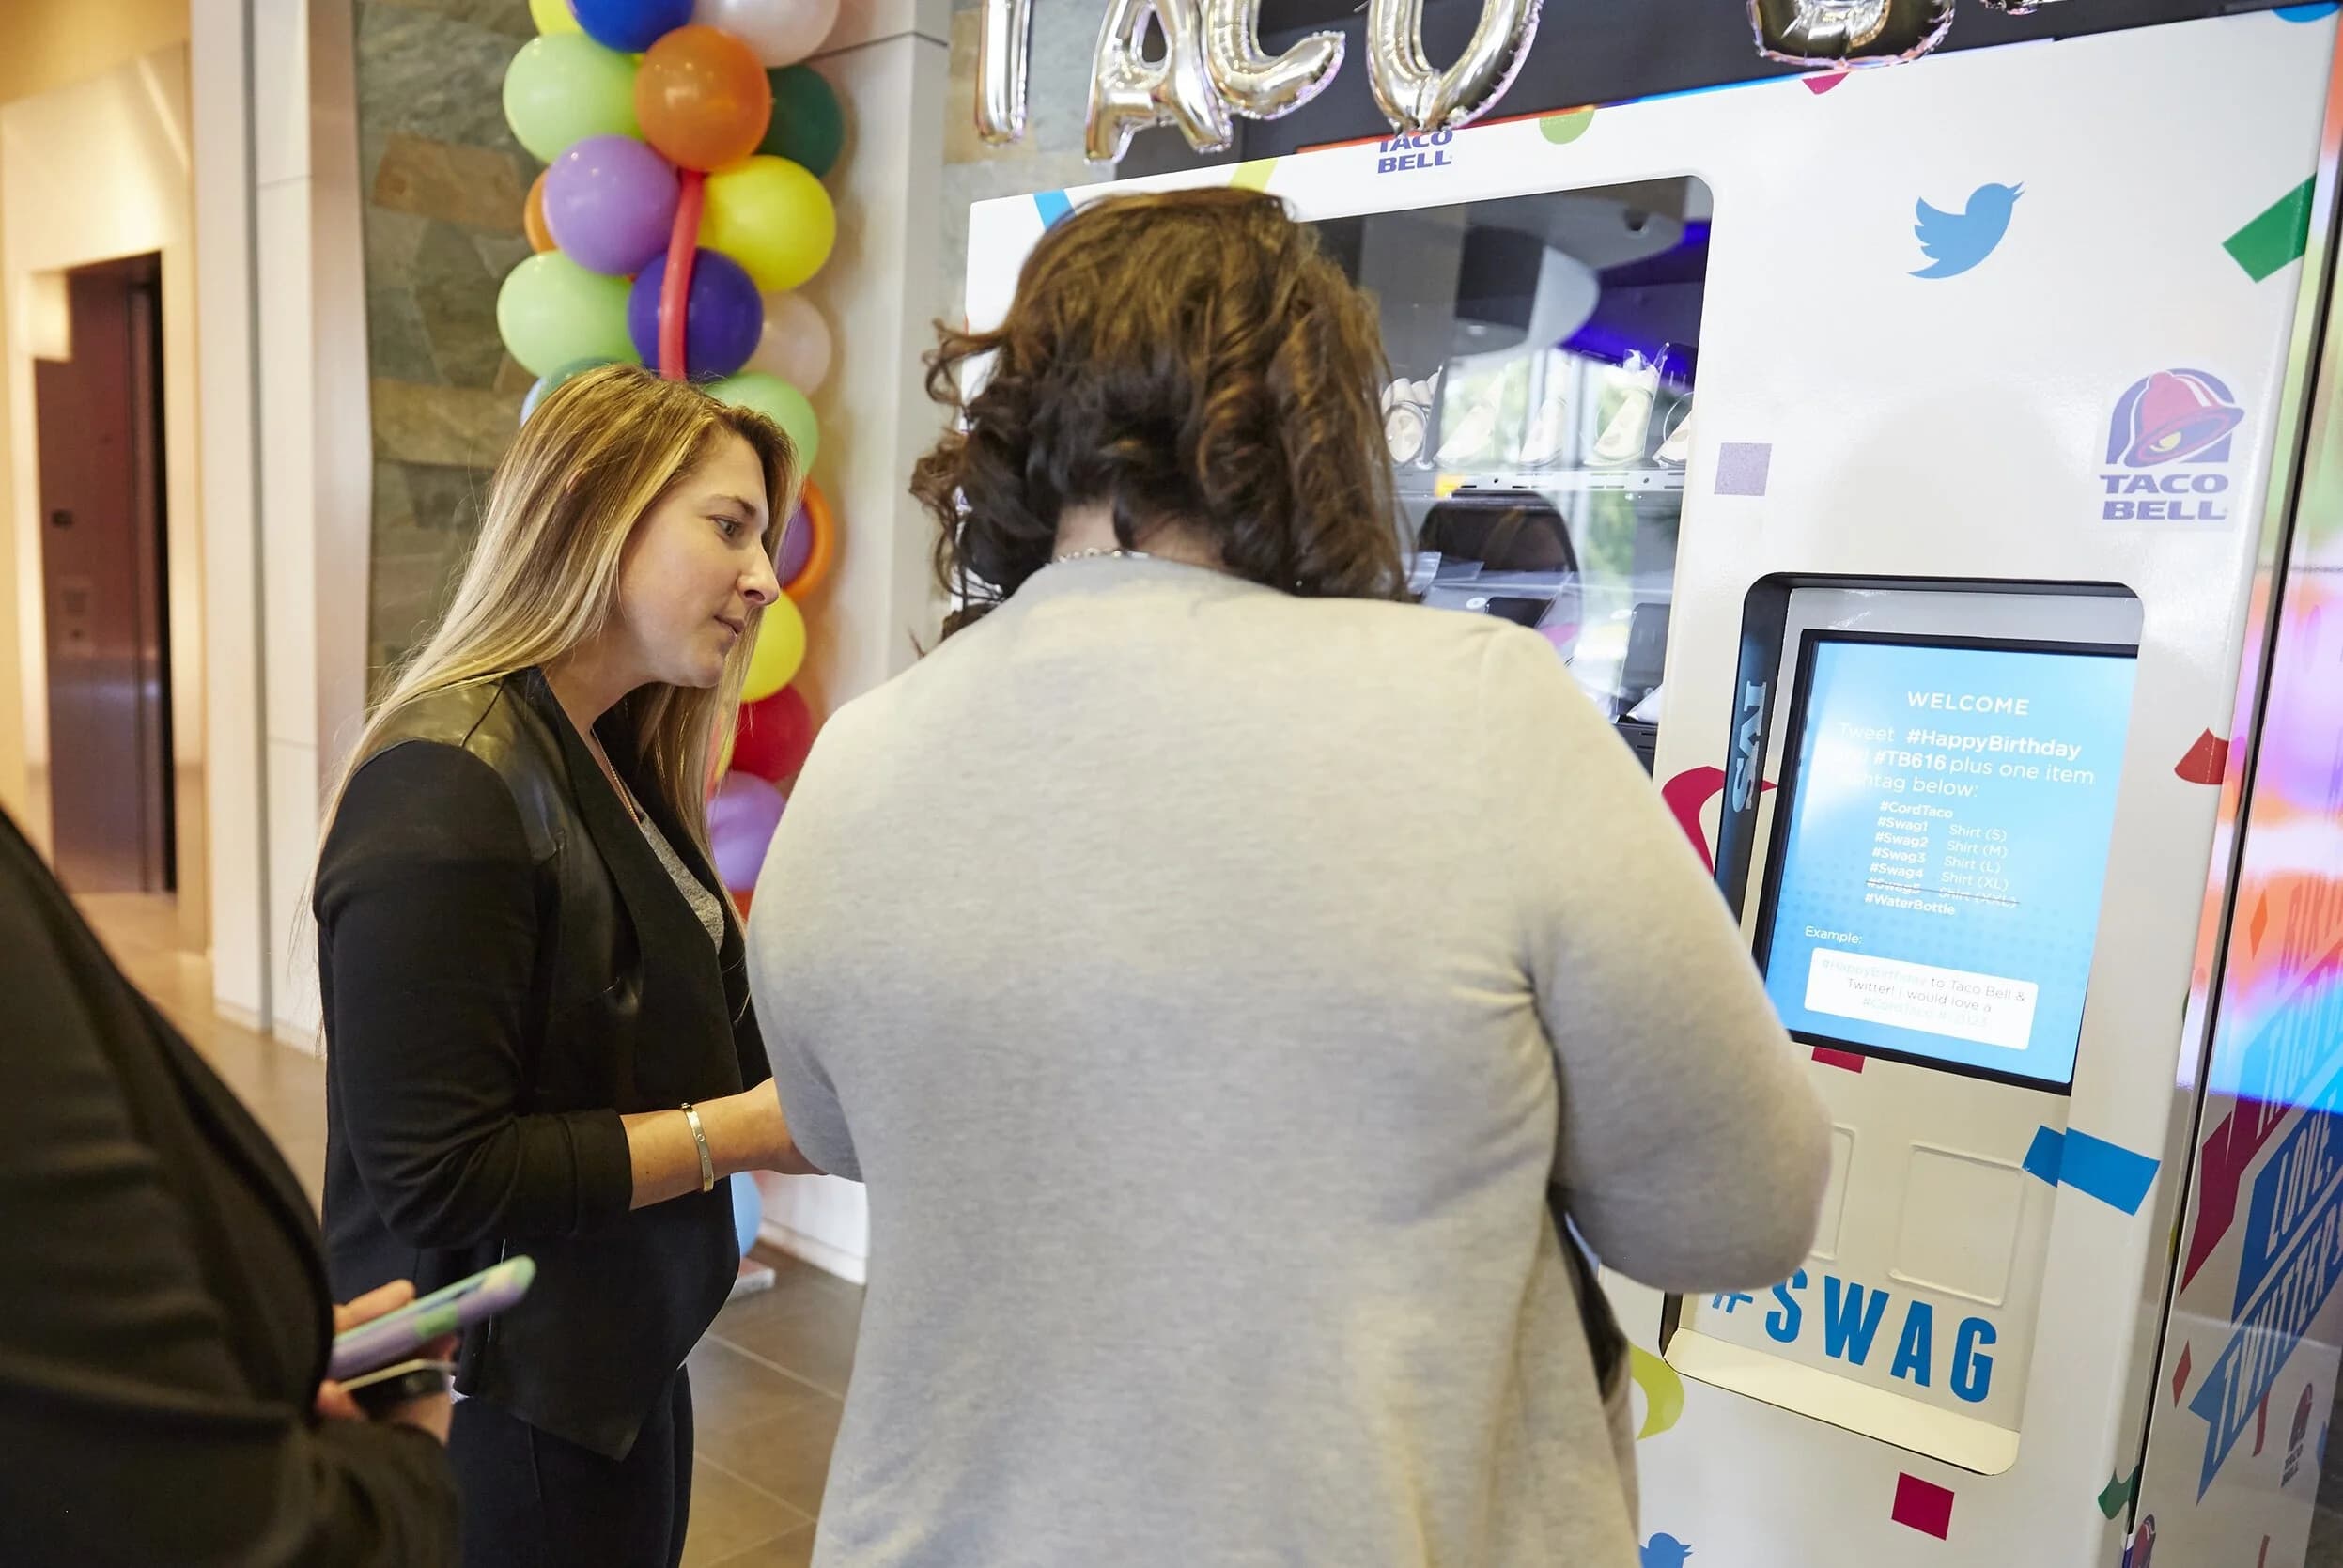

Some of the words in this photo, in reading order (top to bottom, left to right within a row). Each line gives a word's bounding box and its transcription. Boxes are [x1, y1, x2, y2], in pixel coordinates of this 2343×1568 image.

[1378, 150, 1451, 174] BELL
[2099, 474, 2228, 494] TACO
[2102, 501, 2227, 520] BELL
[1907, 691, 2030, 716] WELCOME
[1839, 722, 1895, 742] Tweet
[1906, 728, 2082, 761] #HappyBirthday
[1874, 750, 1947, 771] #TB616
[1949, 756, 1993, 776] plus
[1999, 762, 2039, 779] one
[2046, 763, 2095, 784] item
[1913, 774, 1978, 799] below:
[1879, 800, 1954, 819] #CordTaco
[1876, 816, 1929, 833] #Swag1
[1948, 823, 1981, 838] Shirt
[1985, 828, 2008, 843] (S)
[1874, 831, 1929, 848] #Swag2
[1947, 840, 1978, 855] Shirt
[1983, 845, 2009, 859] (M)
[1871, 847, 1926, 864] #Swag3
[1944, 855, 1976, 870] Shirt
[1980, 861, 2001, 875] (L)
[1870, 862, 1924, 879] #Swag4
[1941, 871, 1973, 886] Shirt
[1977, 877, 2009, 893] (XL)
[1864, 893, 1956, 916] #WaterBottle
[1938, 887, 1970, 902] Shirt
[1805, 925, 1863, 945] Example:
[1848, 977, 1895, 996] Twitter!
[1908, 989, 1947, 1006] would
[1951, 996, 1979, 1012] love
[1983, 1003, 1992, 1014] a
[1932, 977, 1945, 988] to
[1950, 980, 1981, 996] Taco
[1985, 986, 2011, 1001] Bell
[2015, 992, 2026, 1002] &
[2265, 1088, 2338, 1260] LOVE,
[2213, 1203, 2338, 1465] TWITTER
